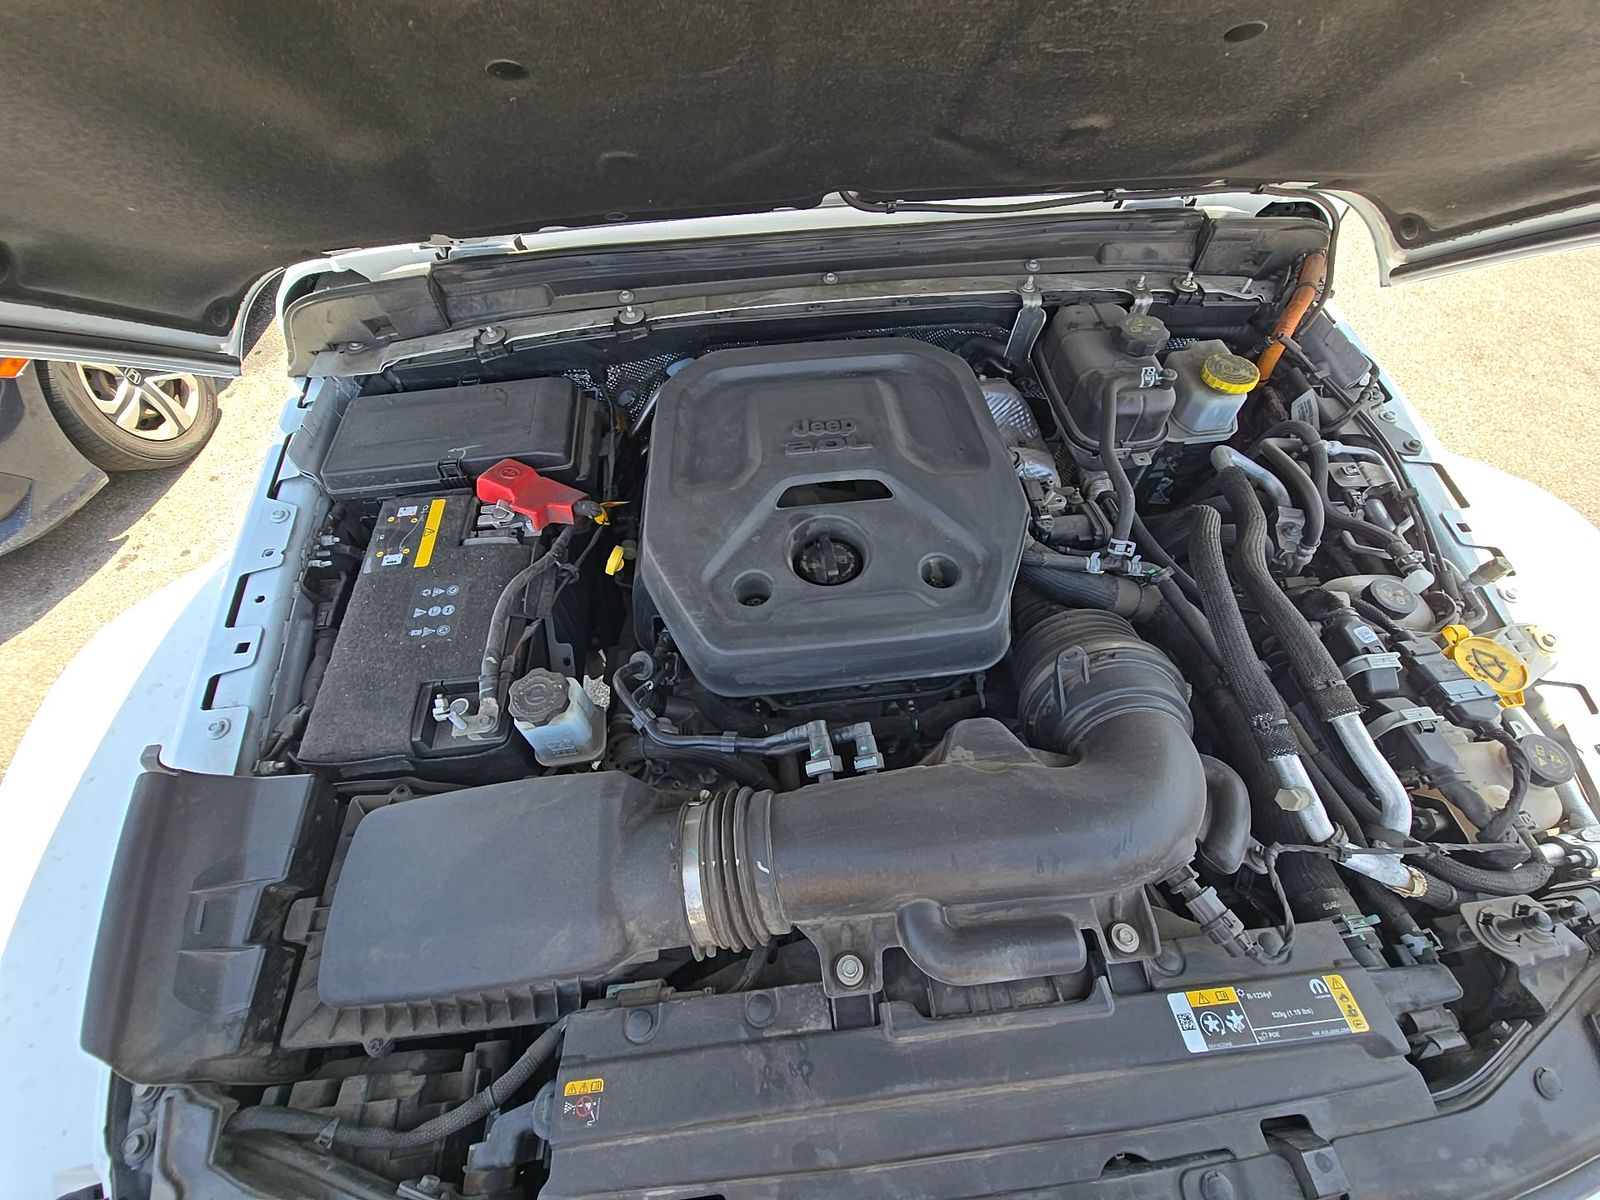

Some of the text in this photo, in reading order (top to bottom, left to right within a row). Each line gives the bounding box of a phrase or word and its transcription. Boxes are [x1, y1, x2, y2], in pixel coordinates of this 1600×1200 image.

[792, 418, 857, 437] Jeep
[784, 437, 873, 456] 2.0L
[1246, 991, 1273, 999] R-1234yf
